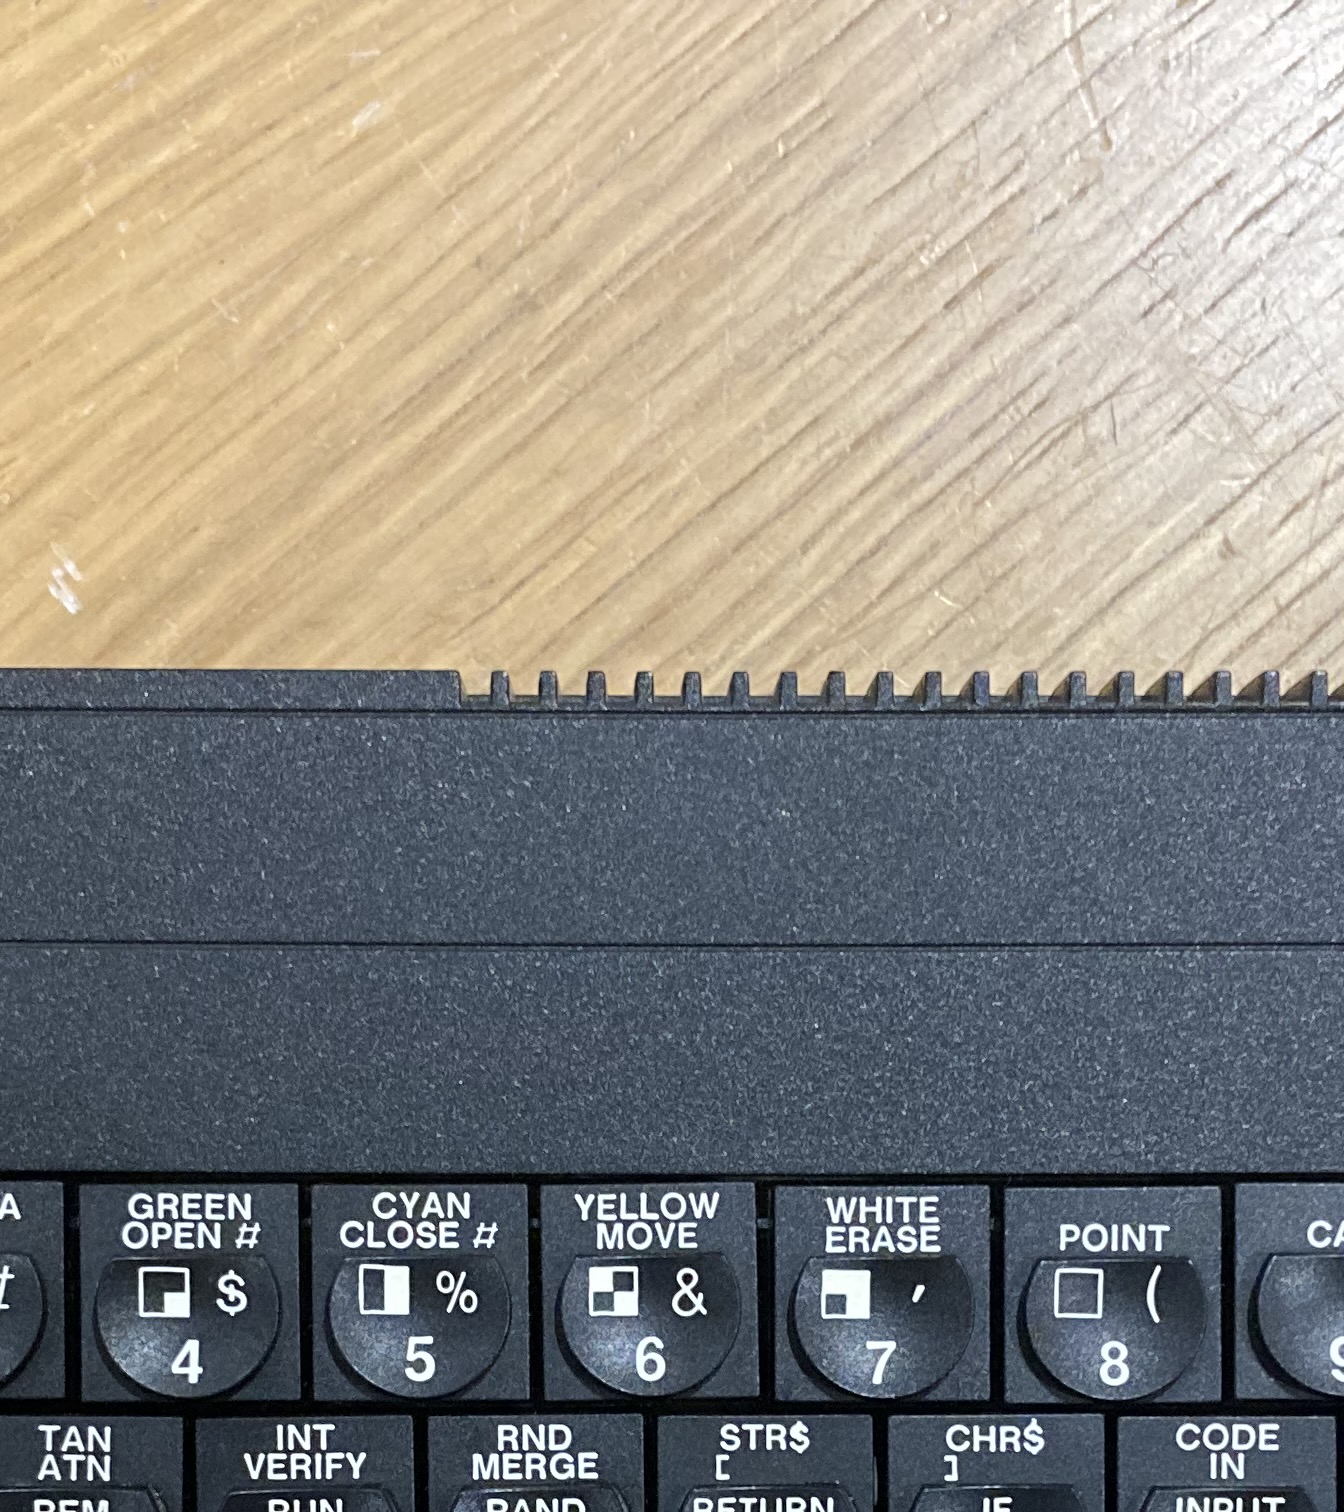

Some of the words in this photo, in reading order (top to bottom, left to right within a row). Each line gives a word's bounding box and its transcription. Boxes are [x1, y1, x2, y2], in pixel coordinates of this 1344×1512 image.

[127, 1192, 252, 1221] GREEN
[372, 1191, 471, 1220] CYAN
[574, 1191, 720, 1222] YELLOW
[823, 1195, 940, 1224] WHITE
[121, 1220, 221, 1250] OPEN
[339, 1220, 460, 1249] CLOSE
[596, 1221, 699, 1251] MOVE
[824, 1224, 942, 1254] ERASE
[1059, 1222, 1171, 1253] POINT
[170, 1338, 204, 1384] 4
[404, 1335, 436, 1382] 5
[633, 1335, 667, 1383] 6
[864, 1339, 898, 1385] 7
[1099, 1339, 1130, 1387] 8
[37, 1424, 112, 1453] TAN
[276, 1423, 336, 1451] INT
[497, 1423, 572, 1452] RND
[719, 1420, 810, 1454] STR$
[945, 1417, 1045, 1456] CHR$
[1175, 1422, 1280, 1451] CODE
[37, 1453, 111, 1482] ATN
[243, 1451, 367, 1480] VERIFY
[472, 1451, 599, 1481] MERGE
[1210, 1452, 1245, 1480] IN
